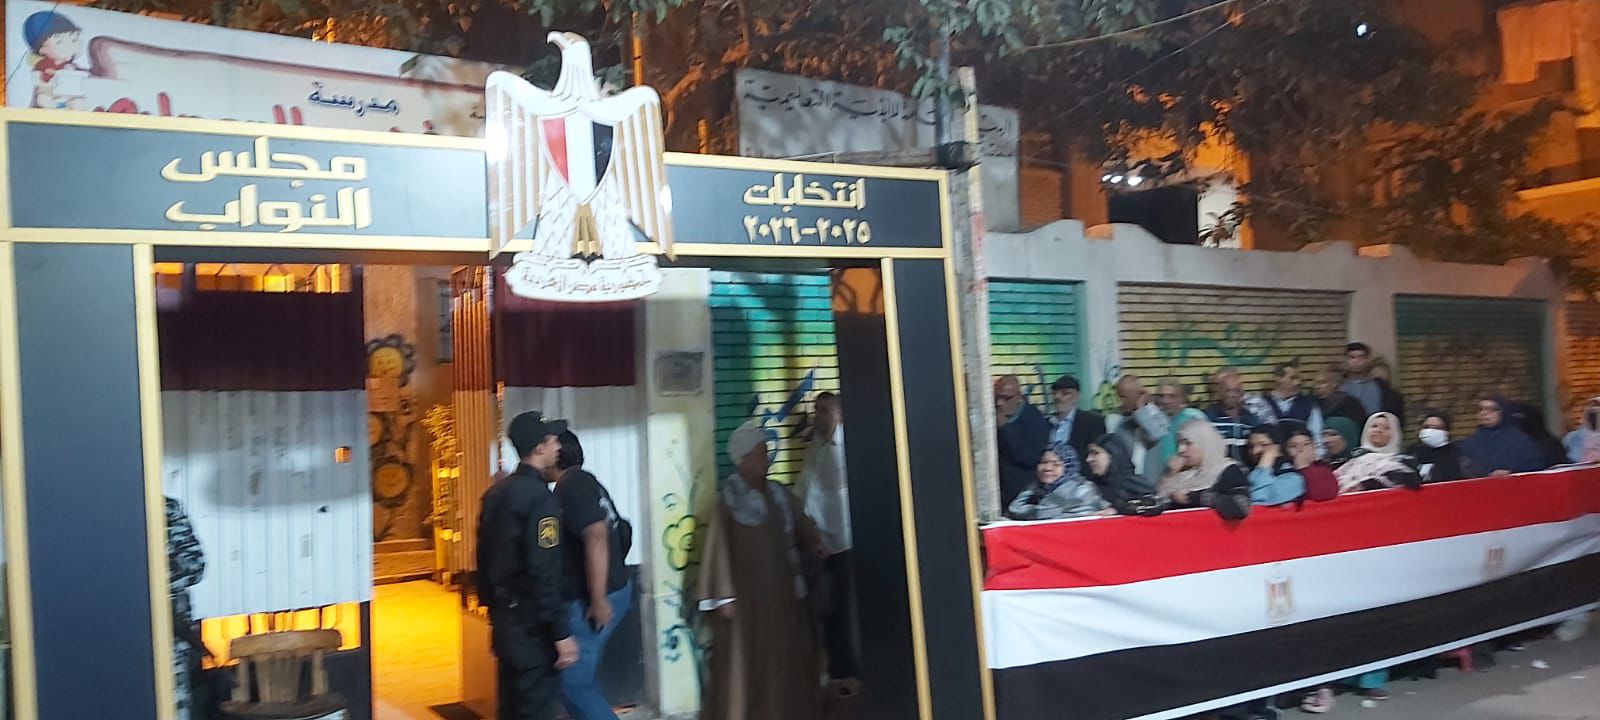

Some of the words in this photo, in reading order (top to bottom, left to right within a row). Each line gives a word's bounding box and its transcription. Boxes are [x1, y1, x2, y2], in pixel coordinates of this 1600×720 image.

[308, 81, 400, 117] مدرسة
[743, 79, 829, 112] التعليمية
[160, 135, 368, 190] مجلس
[165, 184, 373, 233] النواب
[743, 172, 867, 214] انتخابات
